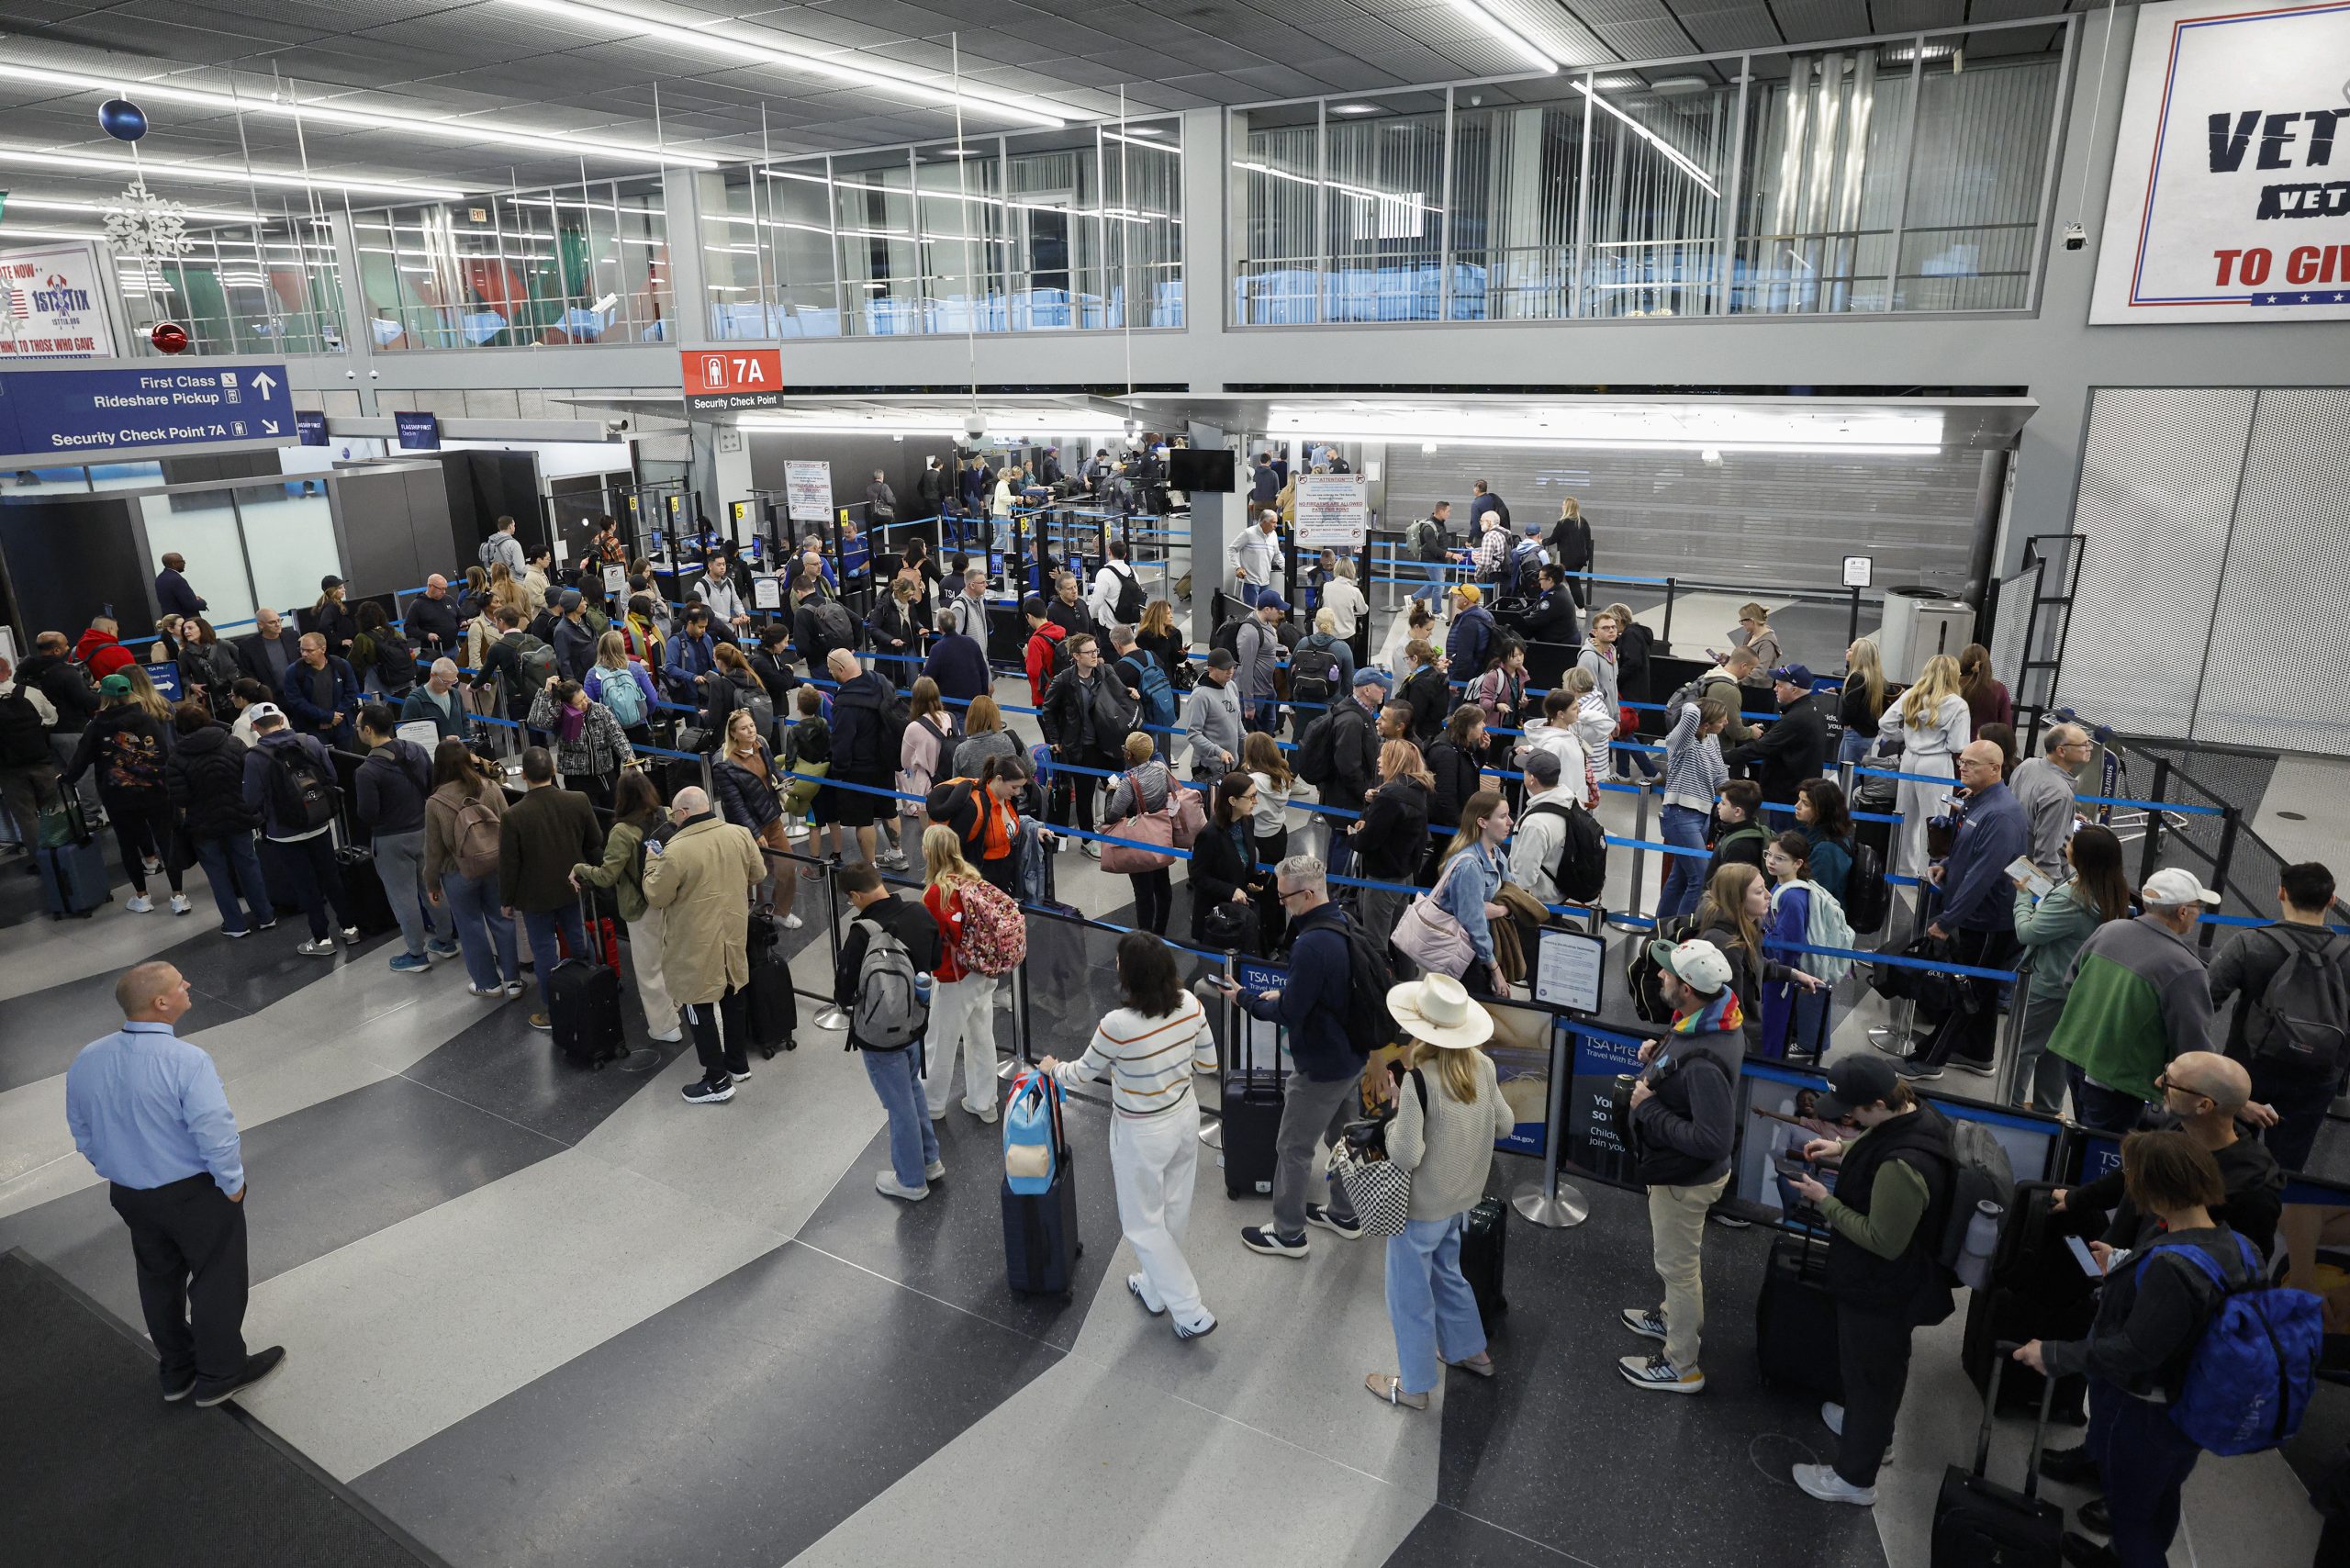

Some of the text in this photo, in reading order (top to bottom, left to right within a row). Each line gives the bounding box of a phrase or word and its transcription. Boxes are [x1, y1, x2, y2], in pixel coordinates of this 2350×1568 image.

[2278, 188, 2347, 211] VET
[472, 209, 485, 220] EXIT
[0, 263, 35, 280] TE NOW
[2213, 247, 2273, 286] TO
[0, 337, 95, 353] HING TO THOSE WHO GAVE
[733, 358, 765, 383] 7A
[140, 374, 216, 389] First Class
[94, 391, 219, 409] Rideshare Pickup
[694, 395, 777, 409] Security Check Point
[51, 424, 226, 447] Security Check Point 7A
[631, 498, 636, 509] 6
[672, 500, 677, 510] 6
[736, 508, 744, 518] 5
[842, 514, 847, 524] 4
[1021, 518, 1026, 530] 3
[1106, 526, 1110, 538] 2
[944, 588, 957, 599] TSA
[1248, 970, 1270, 984] TSA
[1249, 983, 1269, 991] Travel
[1585, 1036, 1611, 1052] TSA
[1586, 1048, 1644, 1069] Travel With Ease
[1592, 1110, 1607, 1122] so
[1510, 1134, 1536, 1145] tsa.gov
[1590, 1126, 1620, 1141] Childr
[1588, 1136, 1606, 1148] join
[2099, 1150, 2121, 1168] TS
